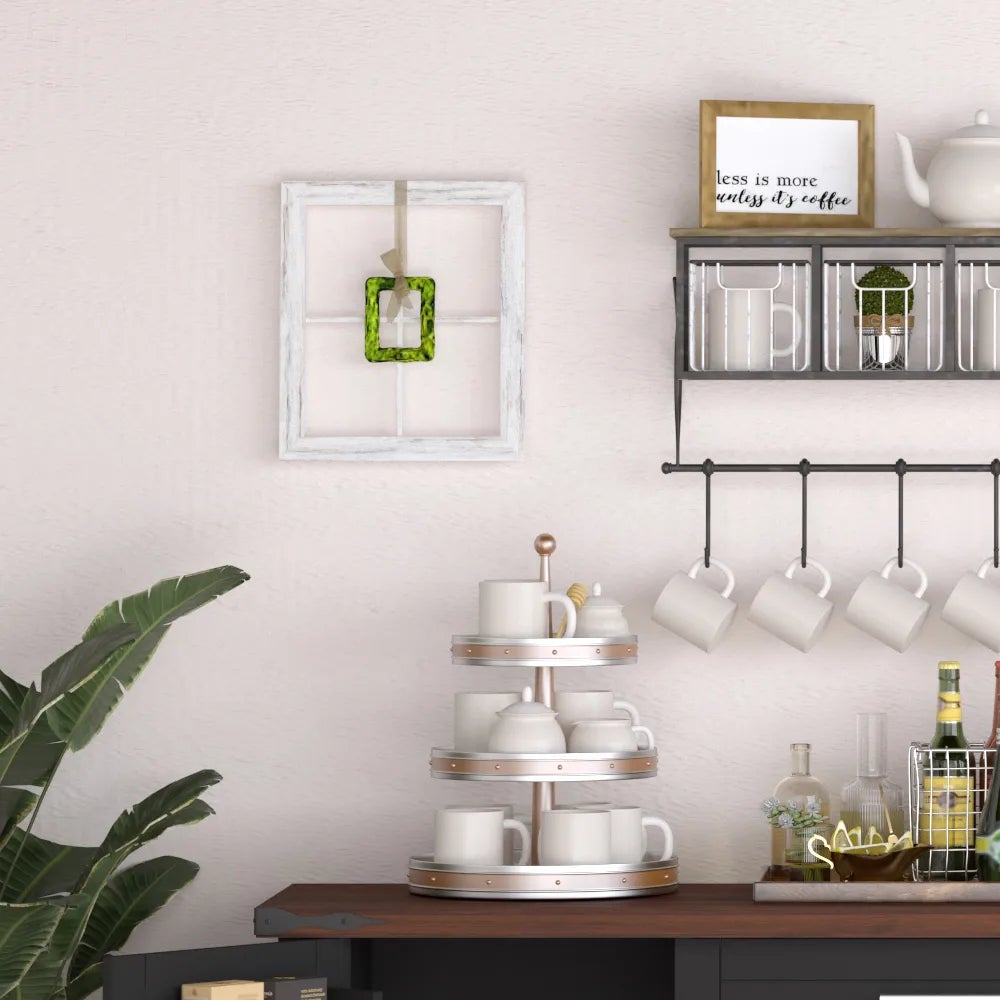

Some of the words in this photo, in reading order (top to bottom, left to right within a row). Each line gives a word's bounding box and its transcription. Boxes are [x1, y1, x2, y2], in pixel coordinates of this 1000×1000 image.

[716, 169, 748, 186] less
[755, 173, 769, 186] is
[777, 175, 818, 187] more
[716, 188, 767, 208] unless
[771, 190, 798, 209] it's
[801, 190, 852, 210] coffee
